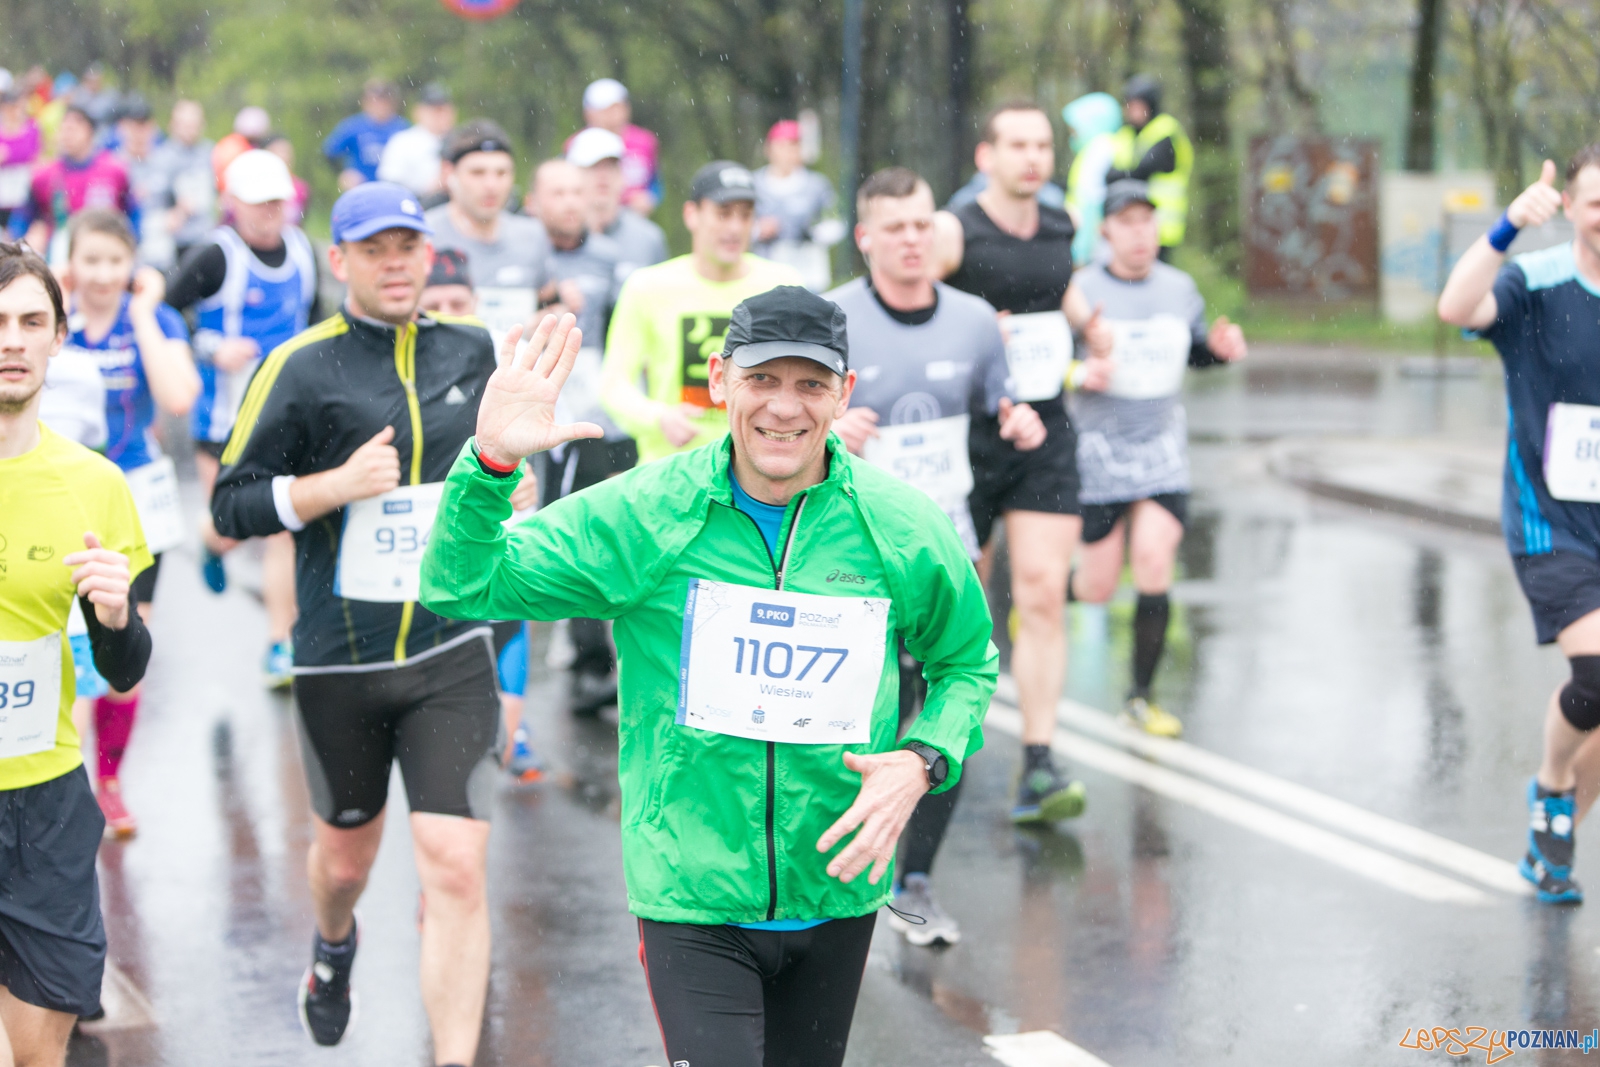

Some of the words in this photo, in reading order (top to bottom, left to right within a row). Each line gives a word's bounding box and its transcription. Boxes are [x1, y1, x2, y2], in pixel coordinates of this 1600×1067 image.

[839, 572, 867, 585] asics
[733, 636, 849, 683] 11077
[759, 683, 814, 699] Wiesław
